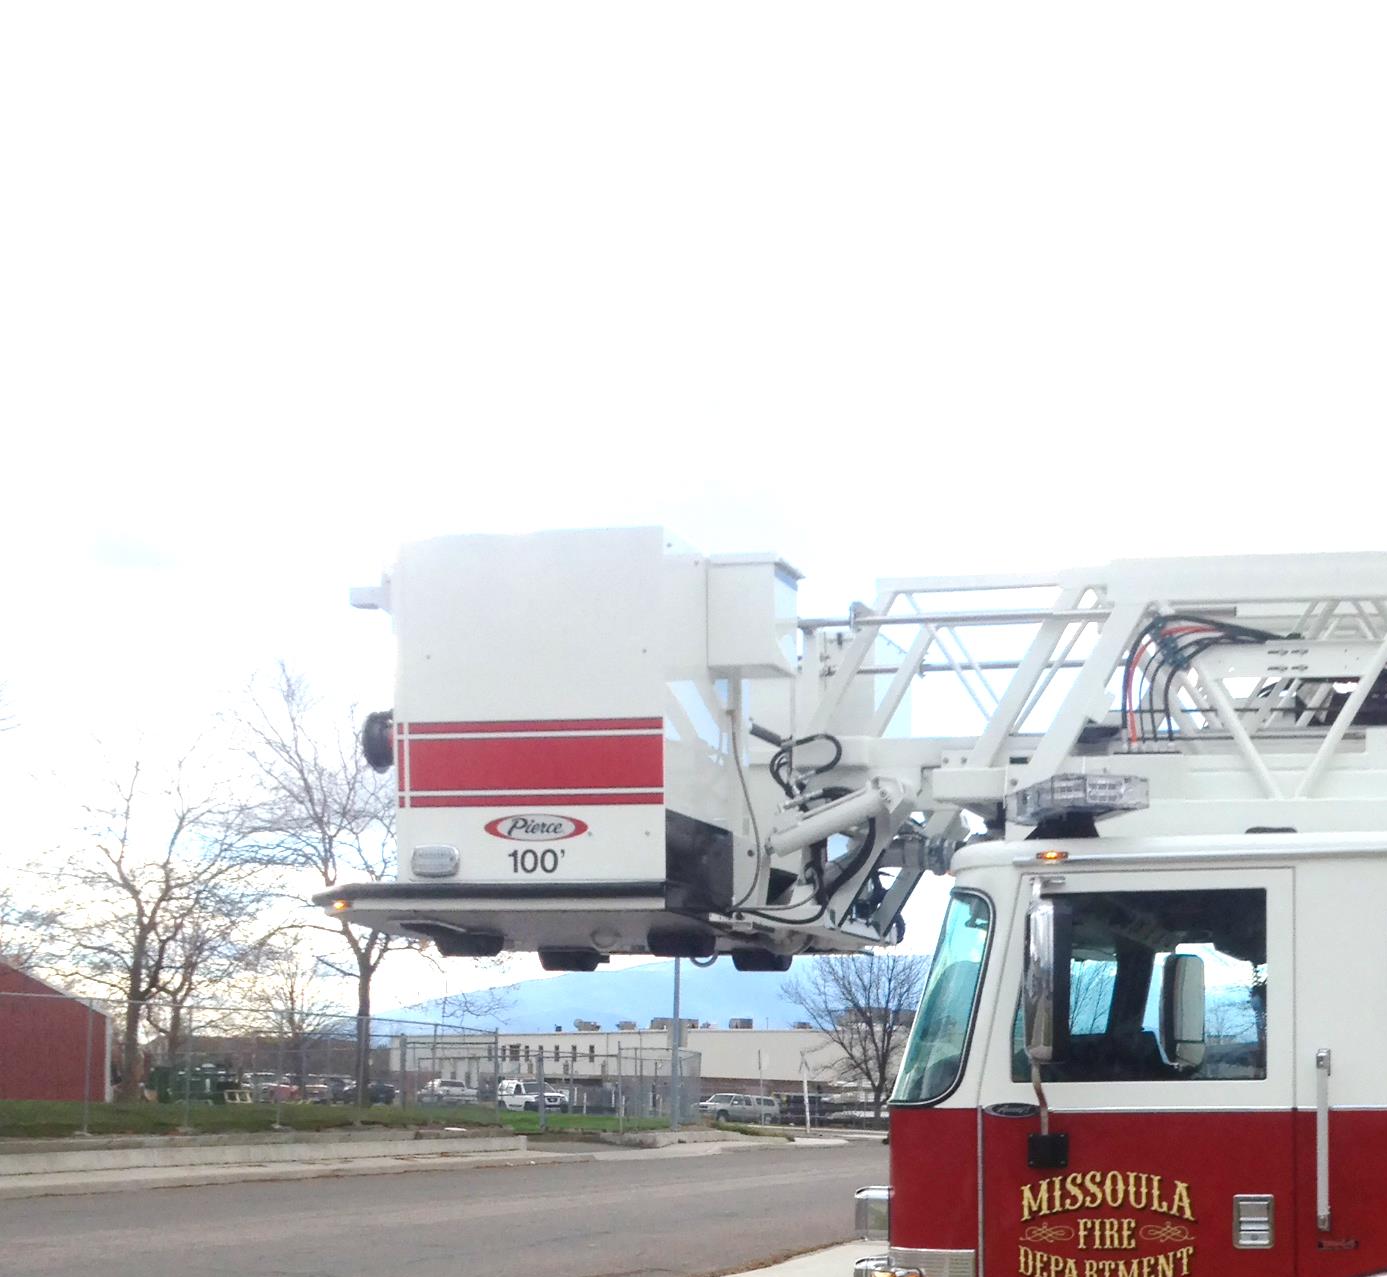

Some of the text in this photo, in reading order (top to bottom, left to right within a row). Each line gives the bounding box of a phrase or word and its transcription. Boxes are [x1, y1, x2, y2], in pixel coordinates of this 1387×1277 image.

[507, 817, 563, 837] Pierce
[508, 848, 565, 874] 100'
[1020, 1170, 1196, 1222] MISSOULA
[1077, 1218, 1136, 1250] FIRE
